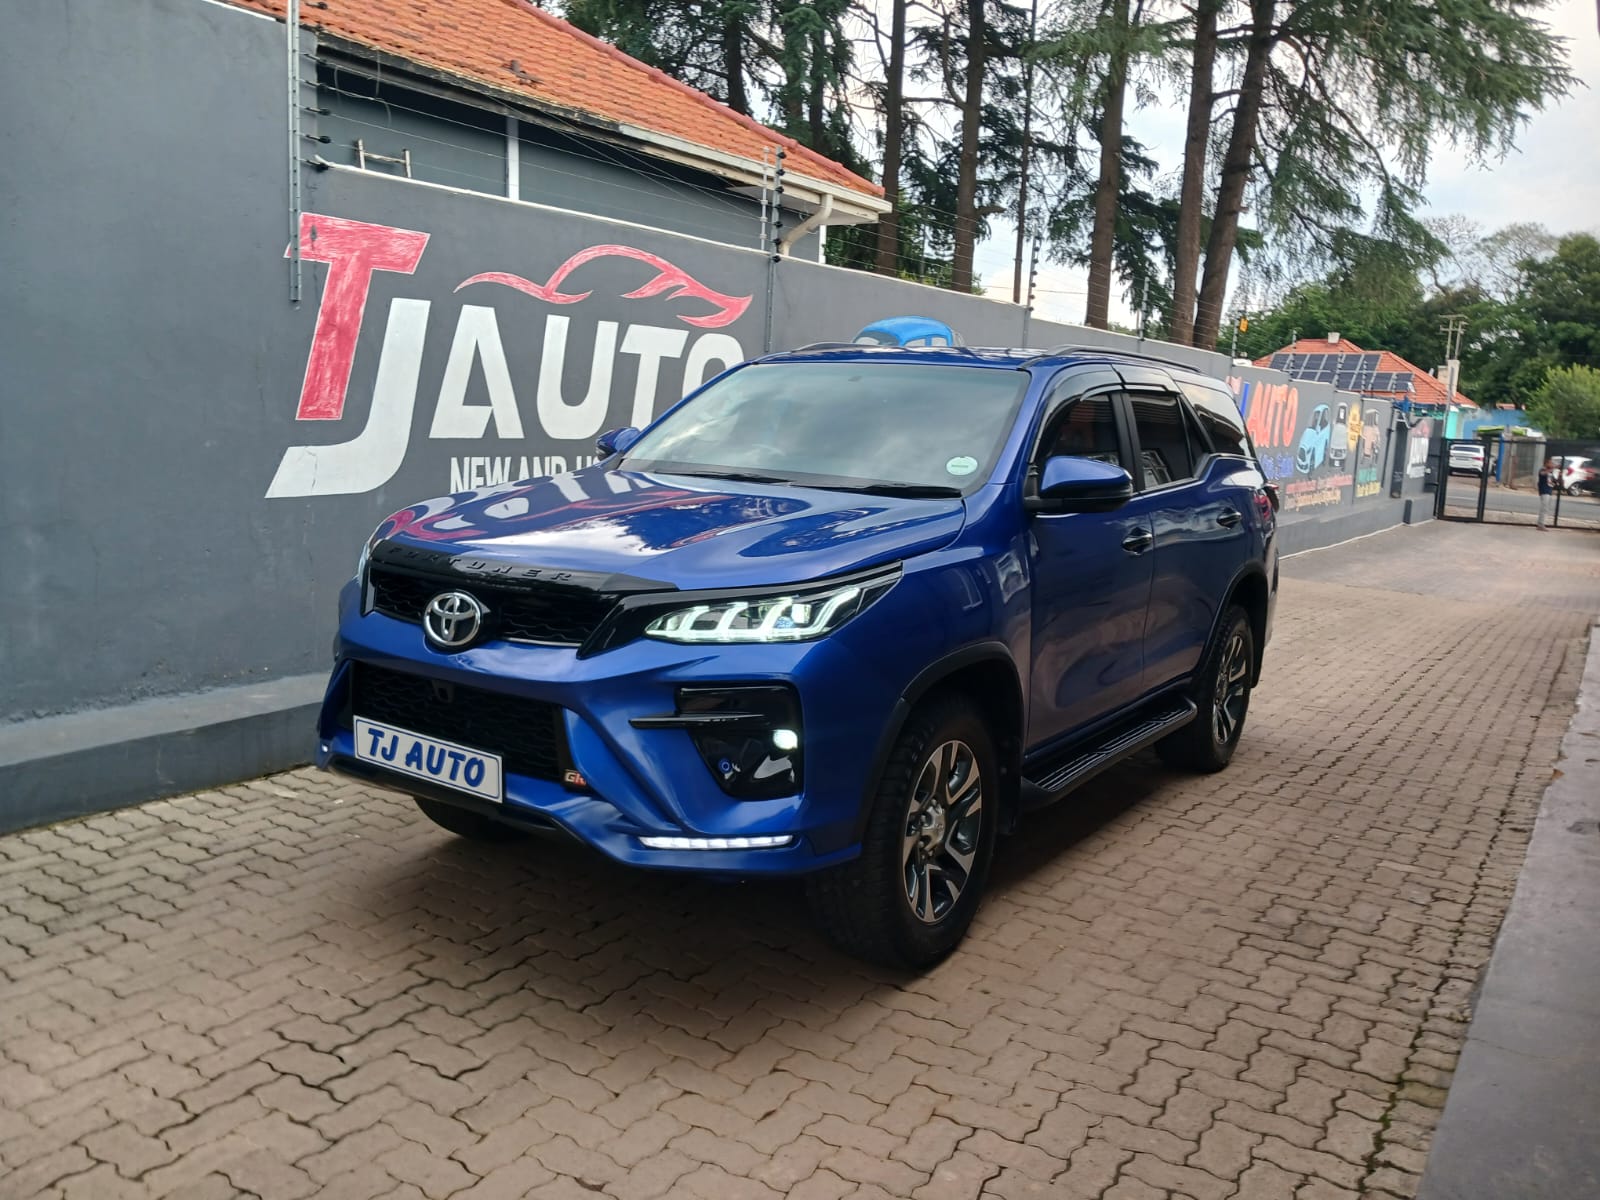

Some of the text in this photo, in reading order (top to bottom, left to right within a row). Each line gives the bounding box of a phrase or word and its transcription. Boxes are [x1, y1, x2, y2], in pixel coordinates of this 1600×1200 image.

[264, 212, 431, 498] TJ
[1247, 381, 1299, 448] AUTO
[368, 727, 486, 788] TJ AUTO
